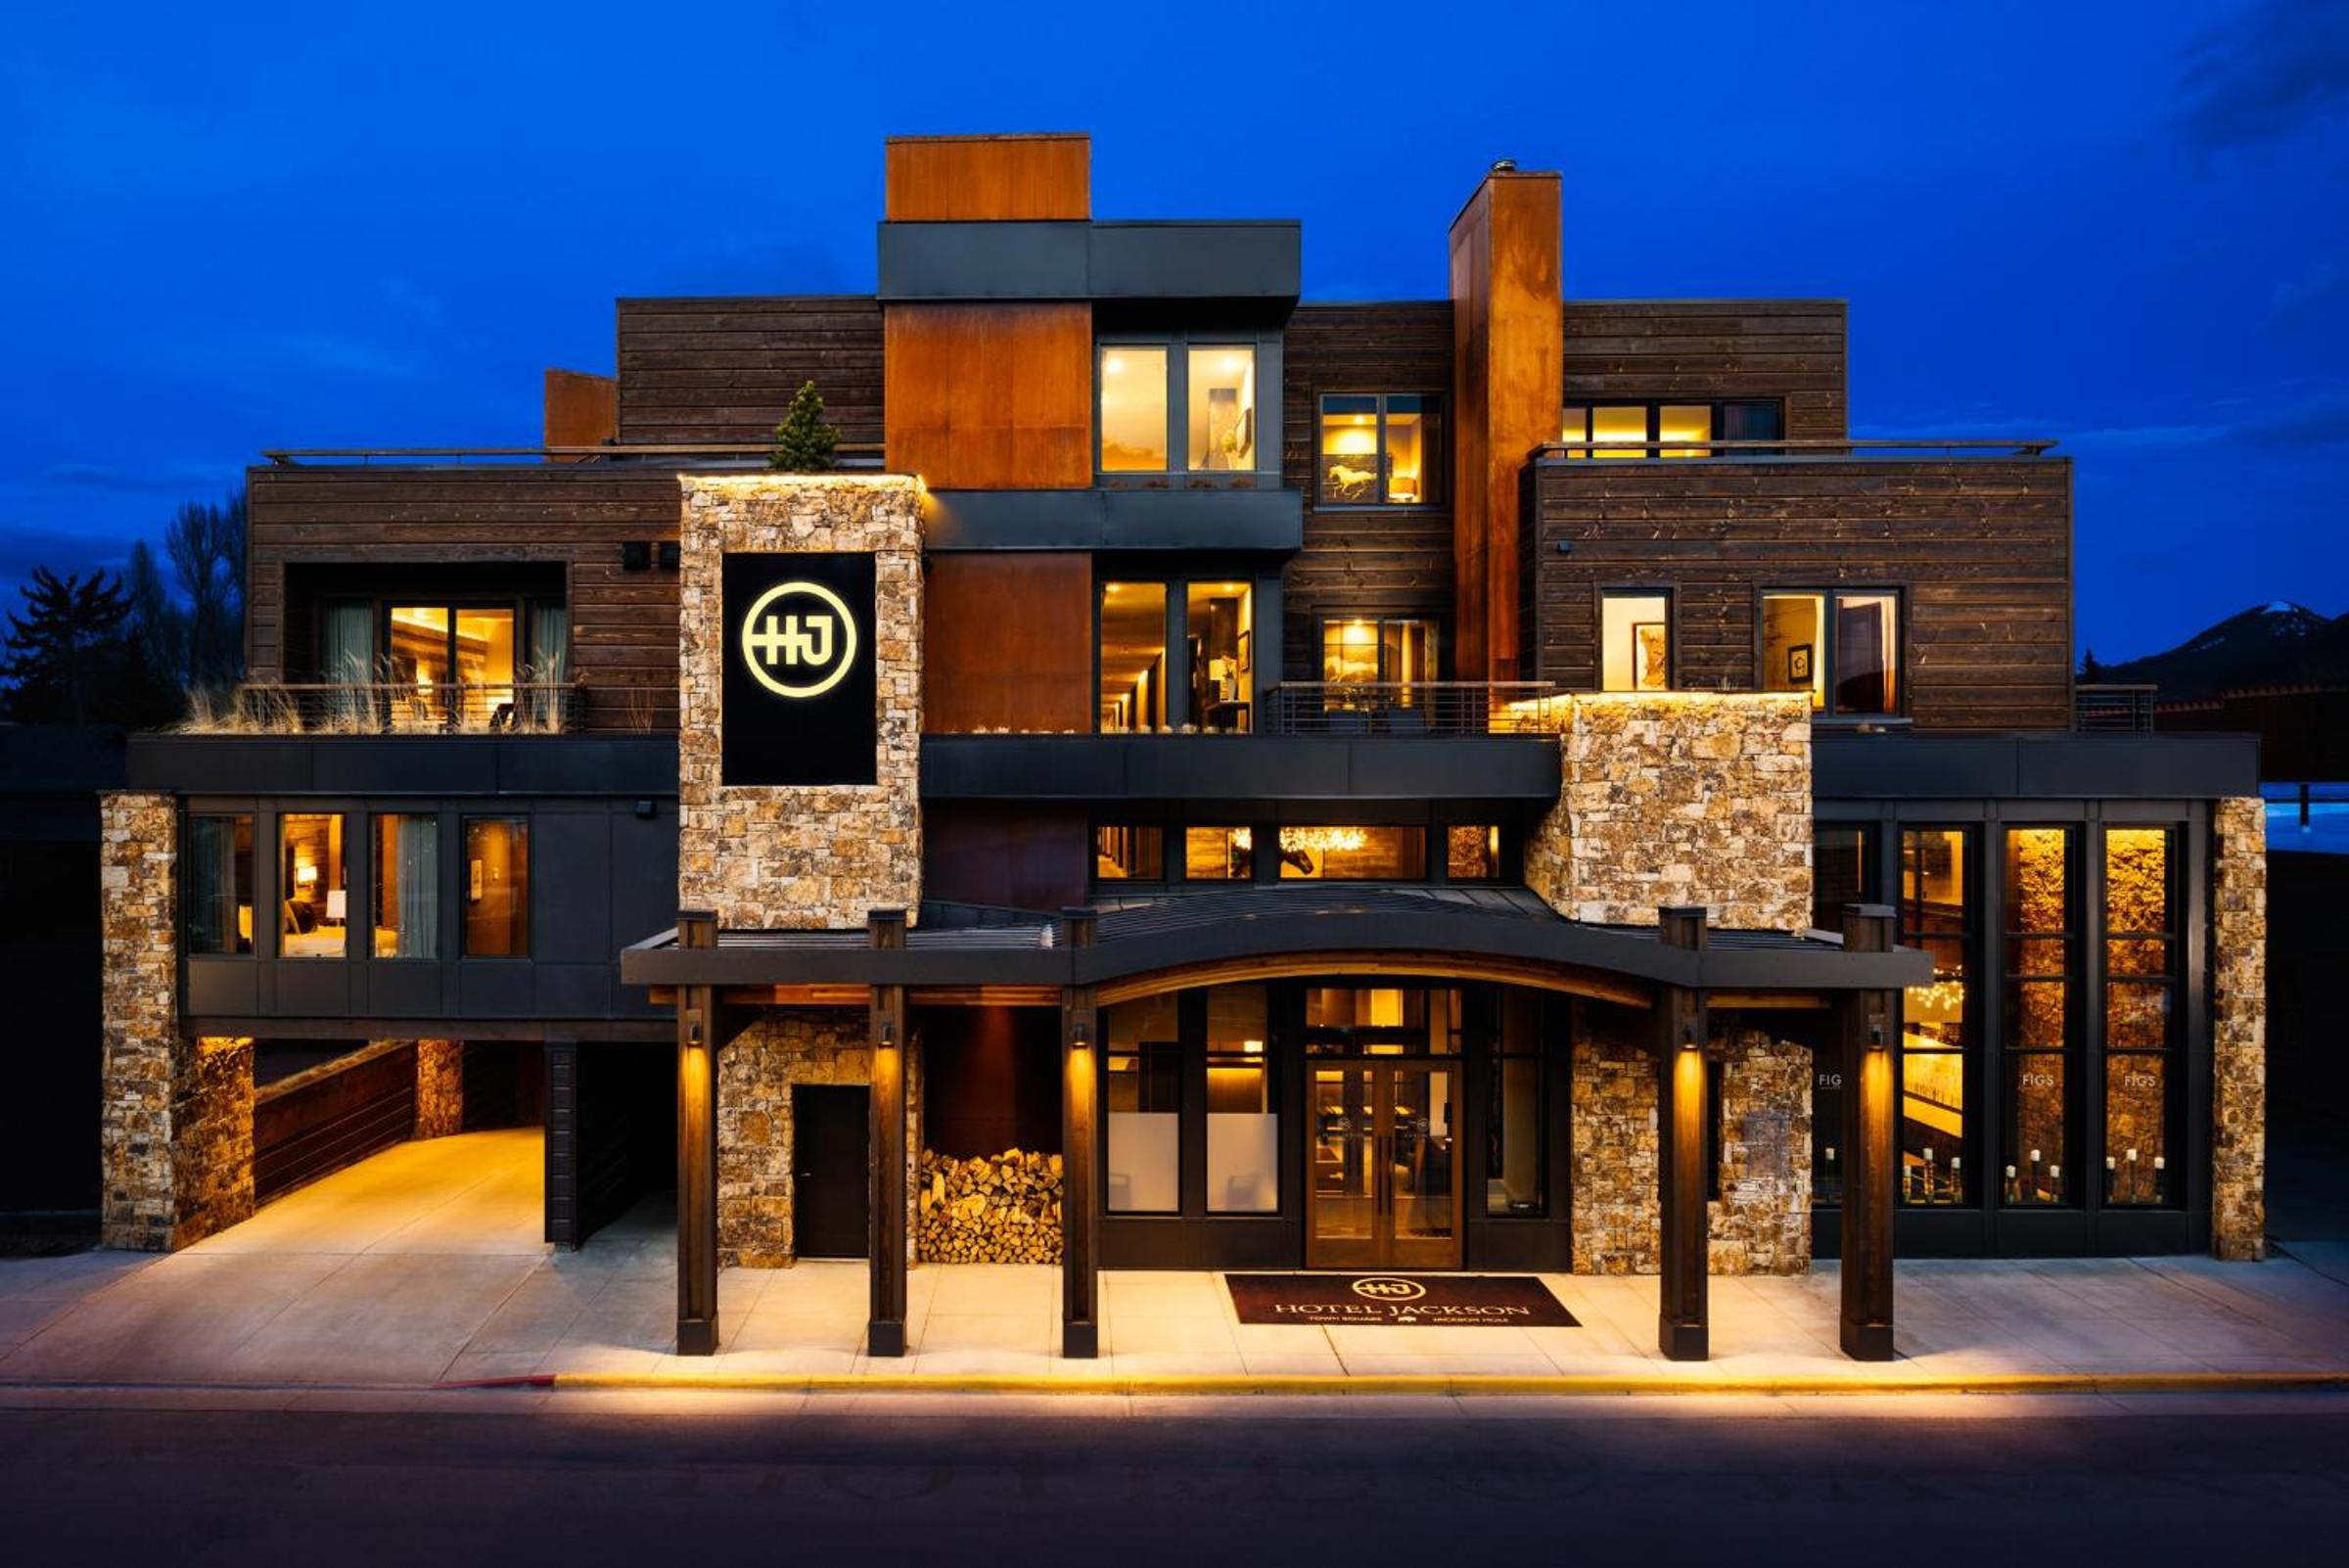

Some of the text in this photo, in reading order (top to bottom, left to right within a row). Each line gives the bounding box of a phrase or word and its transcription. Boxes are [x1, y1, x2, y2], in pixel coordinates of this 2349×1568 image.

[2022, 1073, 2054, 1086] FIGS
[2124, 1074, 2156, 1087] FIGS
[1274, 1304, 1530, 1316] HOTEL JACKSON
